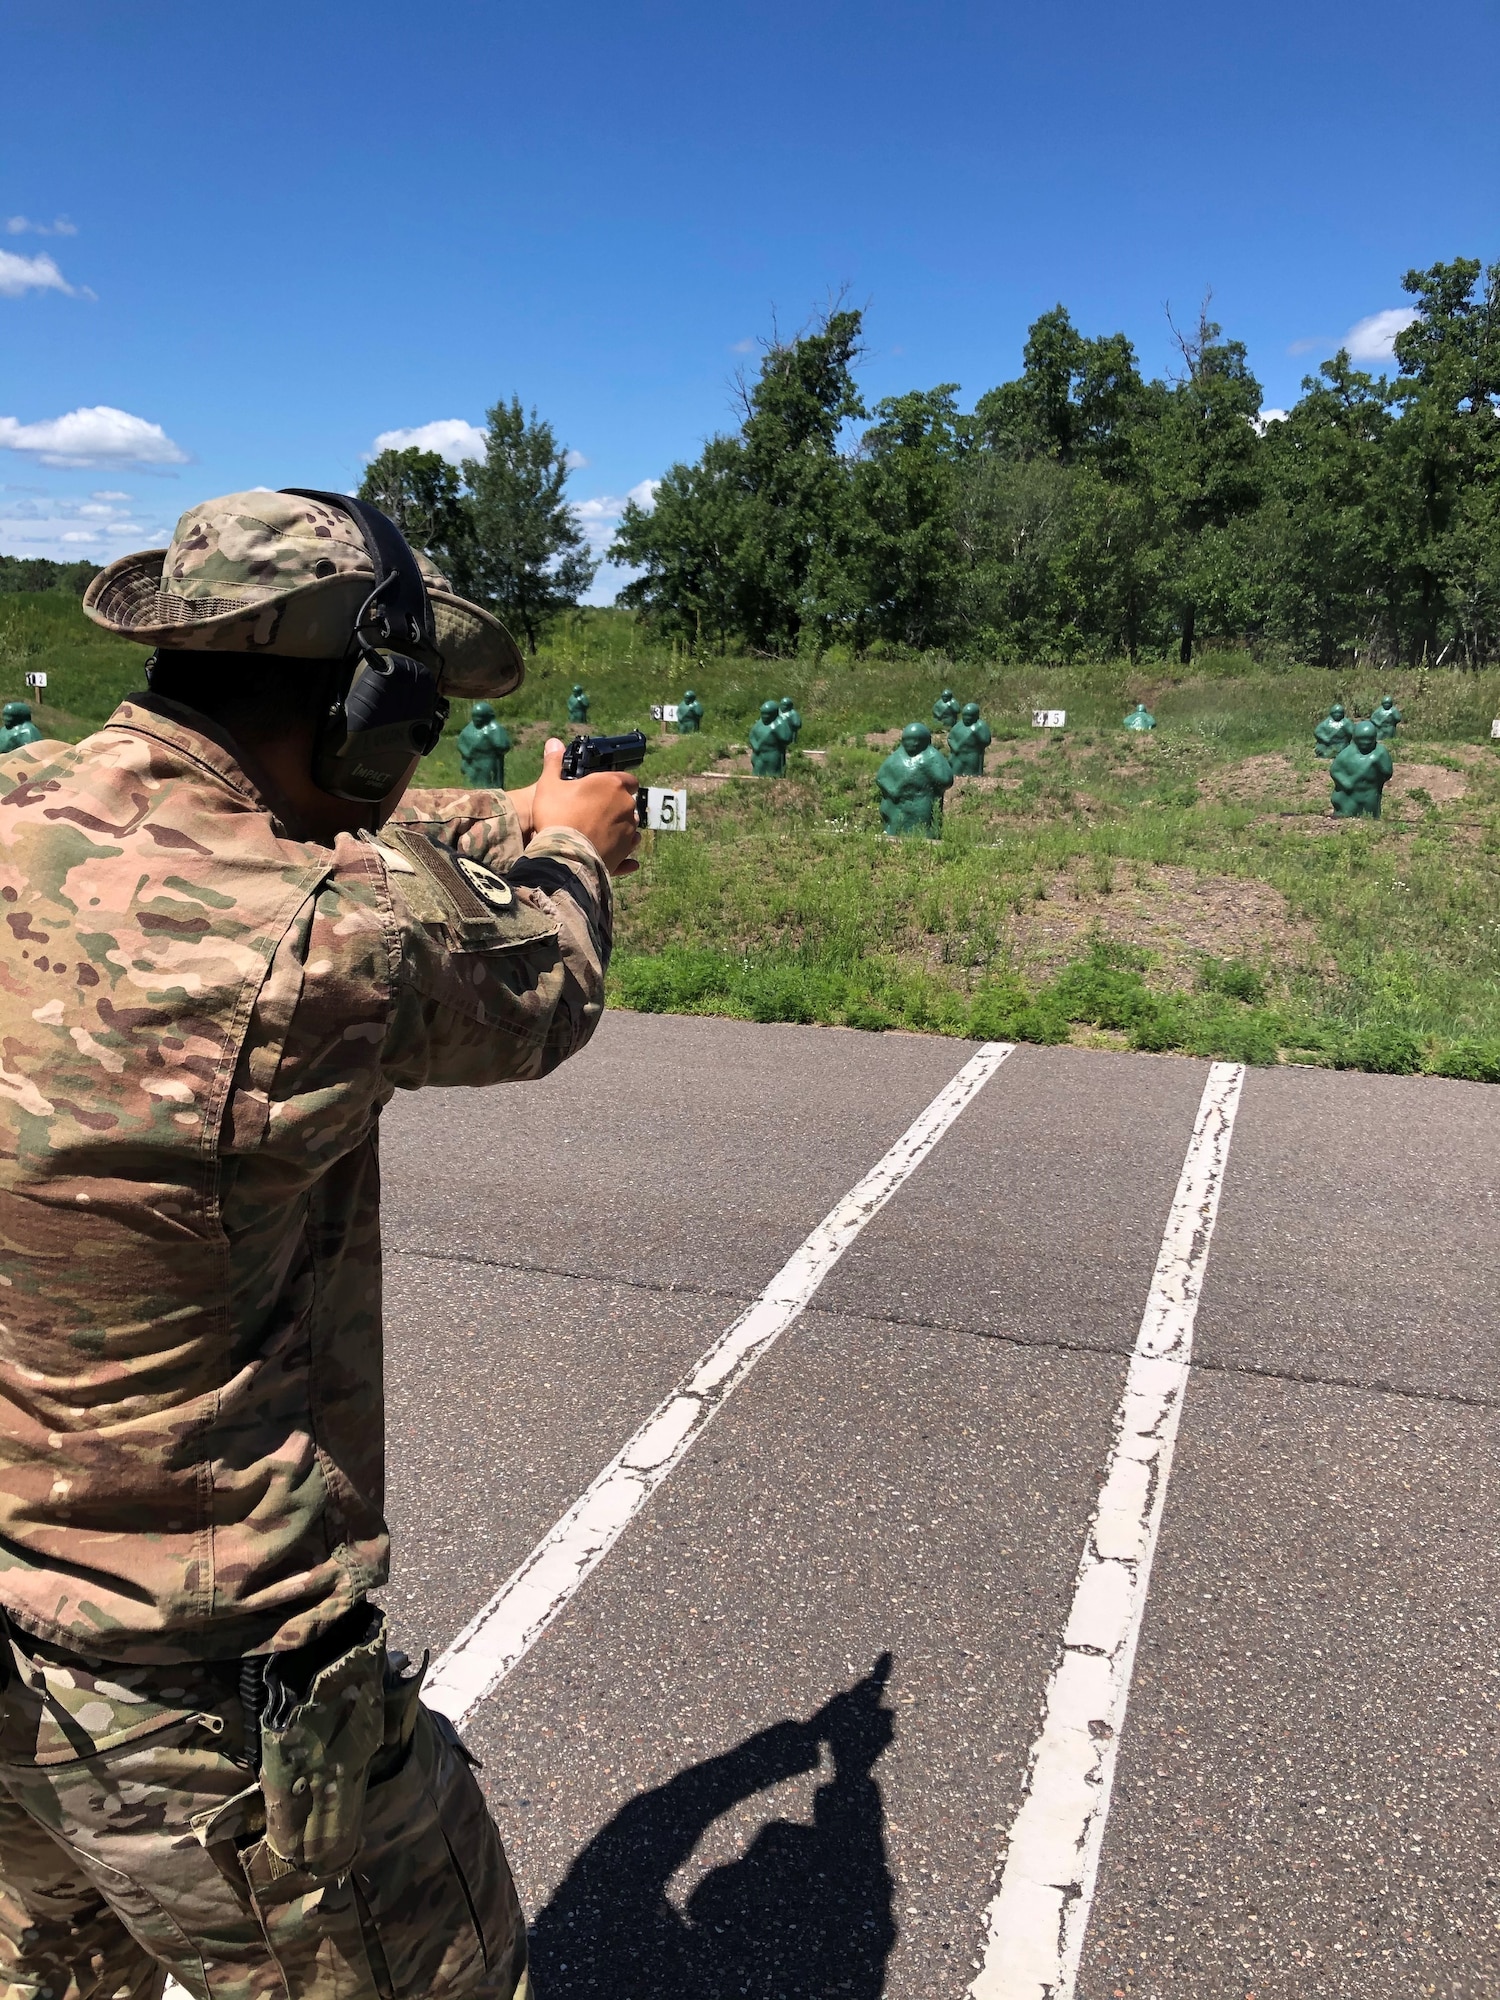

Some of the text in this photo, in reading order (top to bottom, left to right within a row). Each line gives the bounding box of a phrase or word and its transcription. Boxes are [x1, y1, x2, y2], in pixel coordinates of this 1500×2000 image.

[654, 707, 661, 719] 3
[1053, 712, 1060, 725] 5
[660, 795, 675, 824] 5
